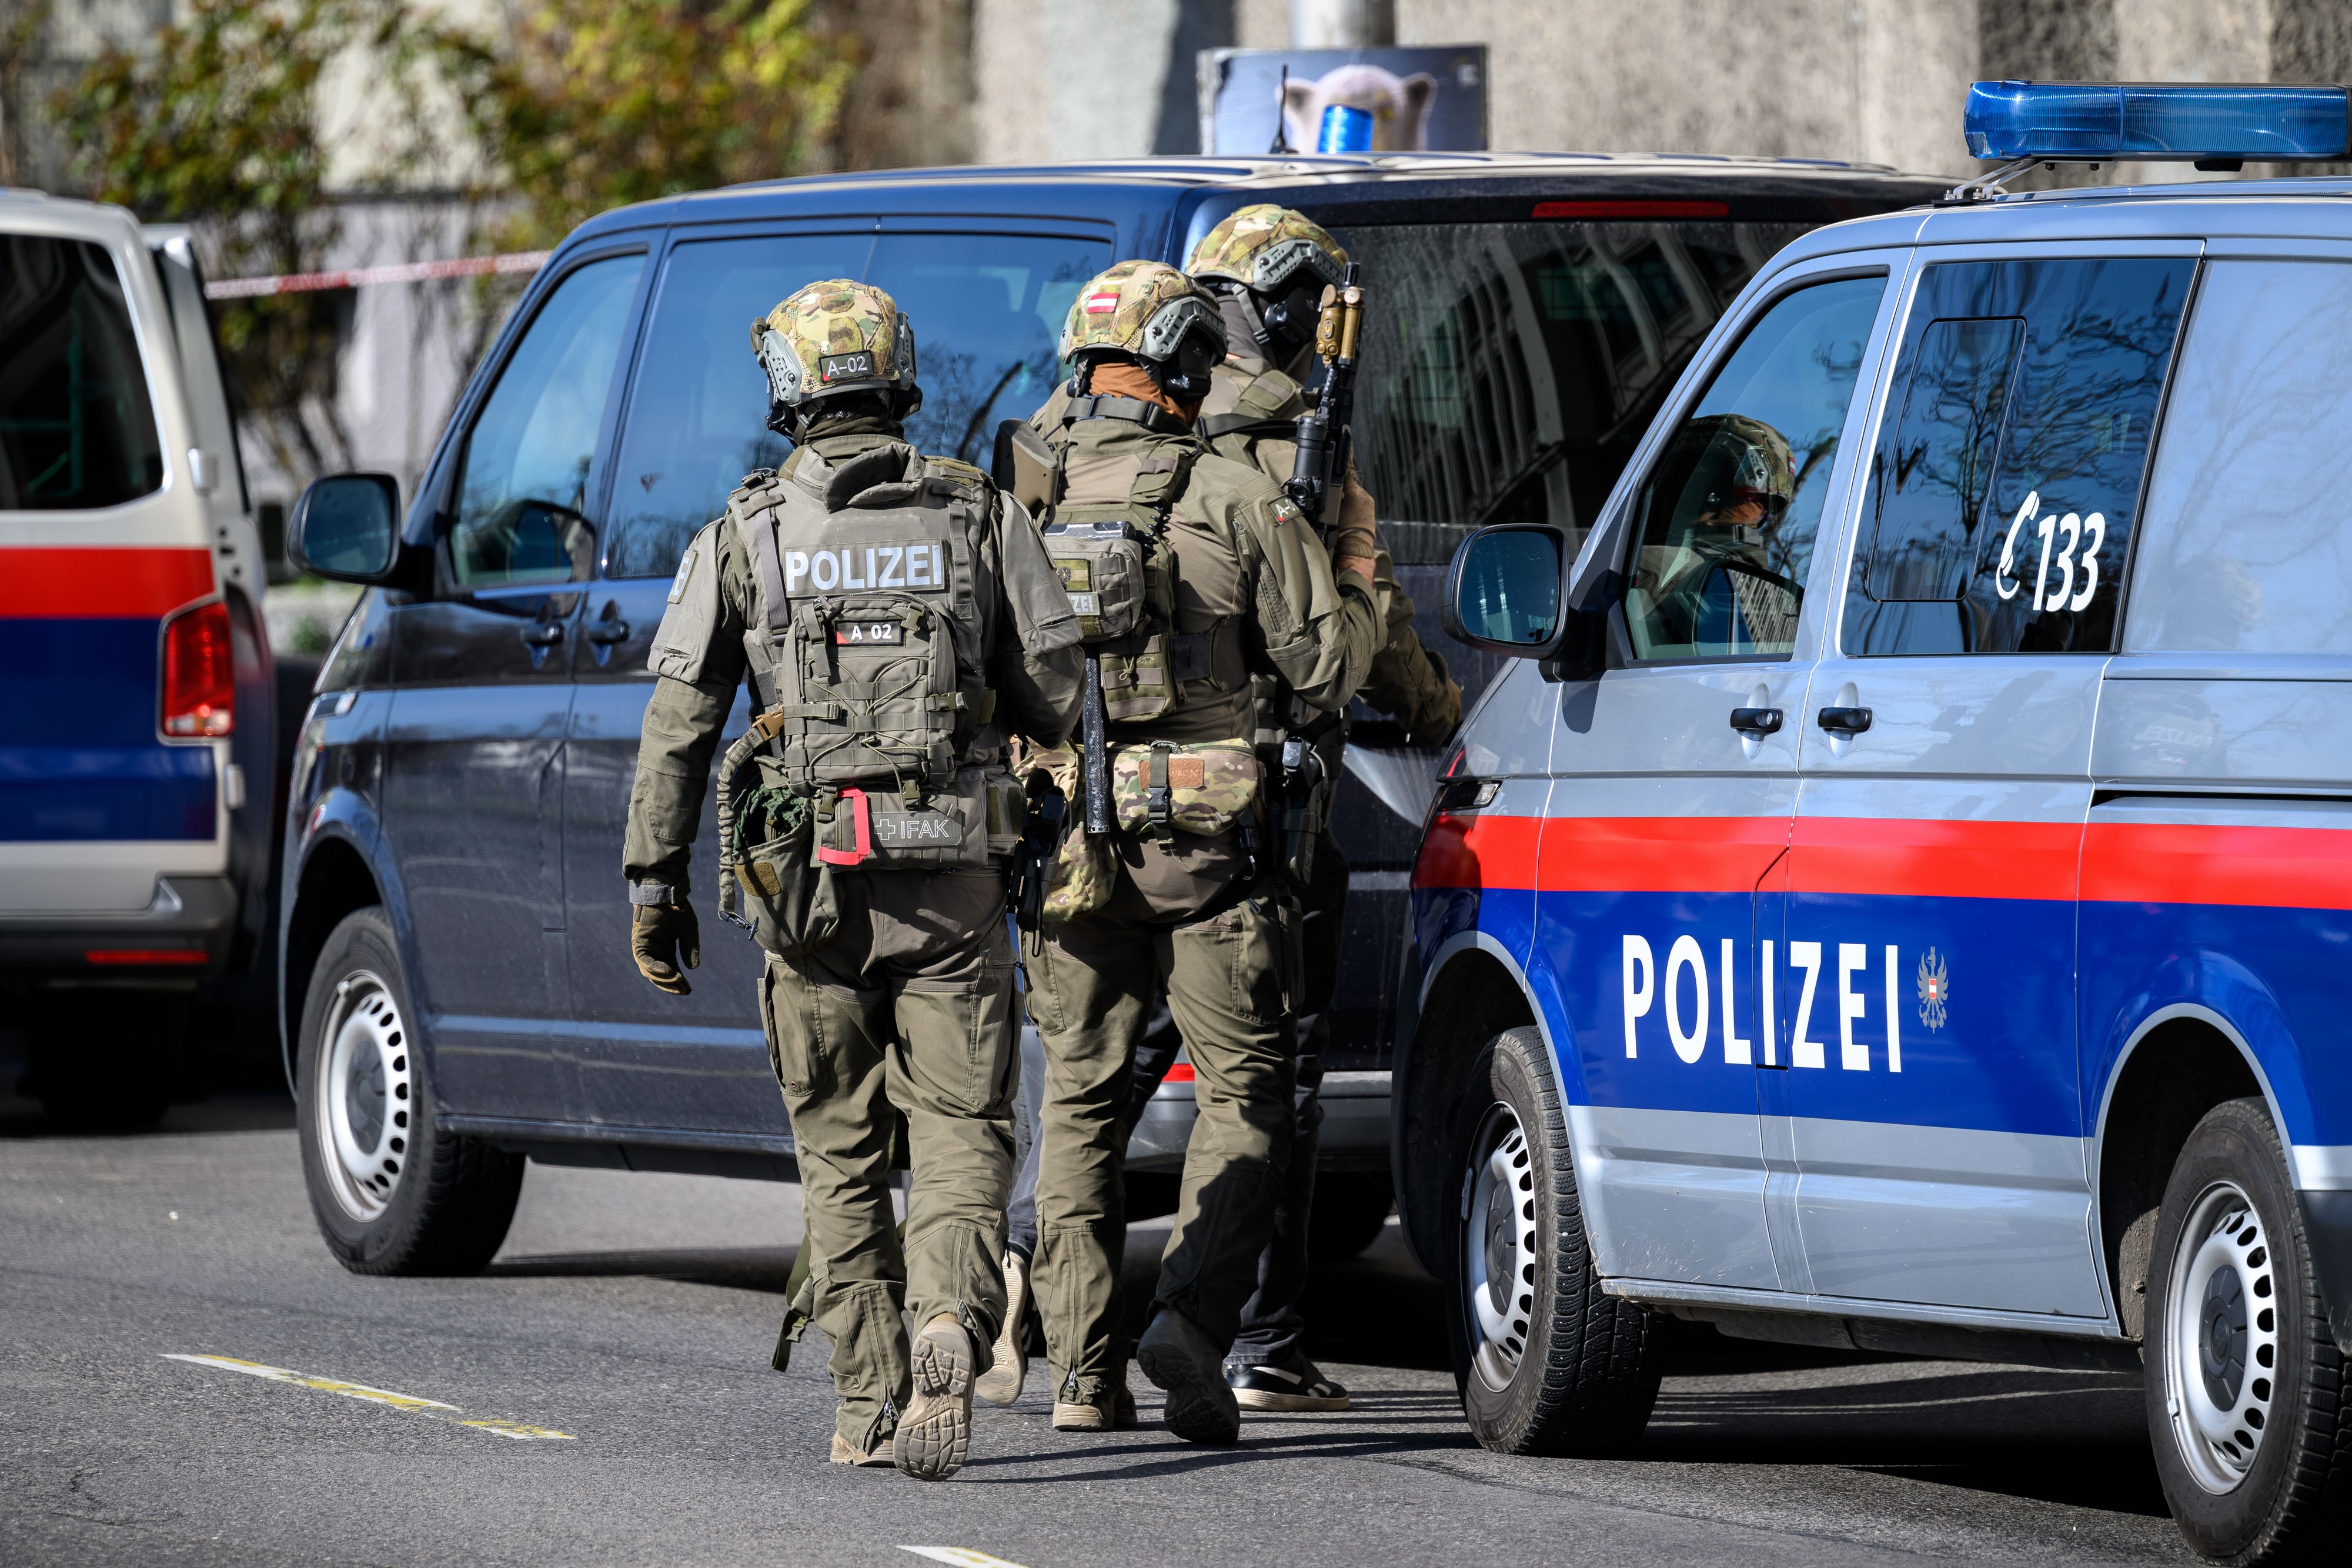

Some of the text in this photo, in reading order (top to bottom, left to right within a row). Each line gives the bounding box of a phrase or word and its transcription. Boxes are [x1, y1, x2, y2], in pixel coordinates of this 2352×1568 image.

[828, 356, 867, 376] A-02
[1275, 499, 1299, 518] A-0
[786, 544, 942, 591] POLIZEI
[2033, 512, 2106, 612] 133
[900, 819, 949, 839] IFAK
[1623, 934, 1902, 1073] POLIZEI
